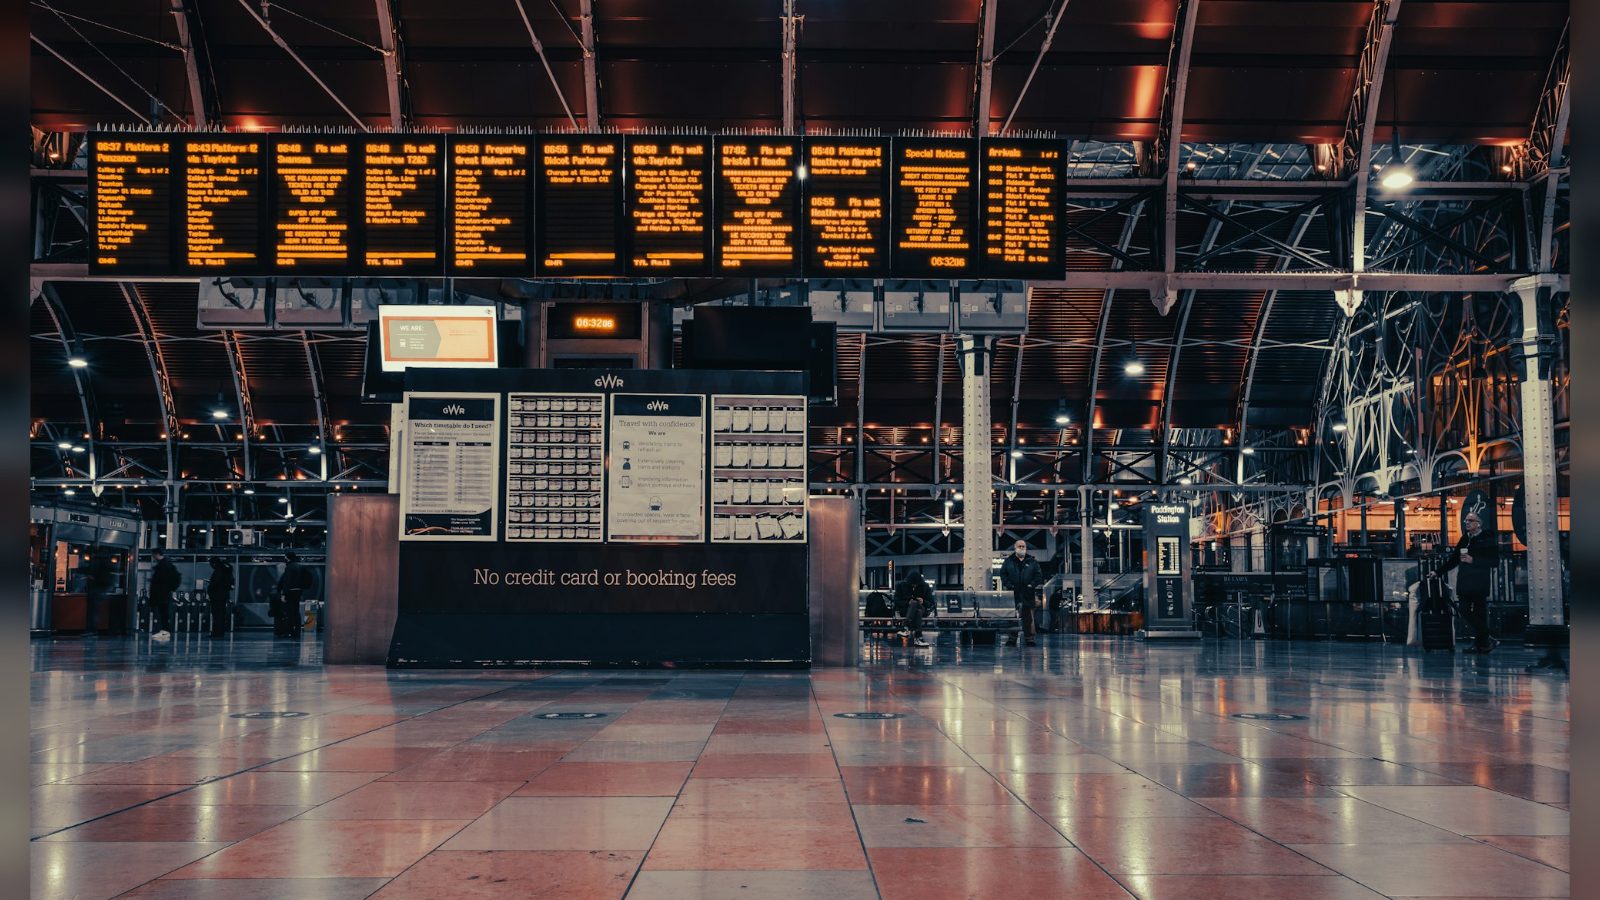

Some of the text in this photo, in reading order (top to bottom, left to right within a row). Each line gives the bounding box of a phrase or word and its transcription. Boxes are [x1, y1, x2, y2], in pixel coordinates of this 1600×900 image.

[162, 143, 170, 152] 2
[485, 145, 525, 154] Preparing
[723, 146, 746, 155] 07:02
[906, 149, 965, 158] Special Notices
[989, 148, 1021, 157] Arrivals
[97, 154, 136, 162] Penzance
[202, 155, 236, 164] Twyford
[366, 156, 404, 164] Heathrow
[455, 156, 513, 165] Great Malvern
[544, 156, 606, 166] Didcot Parkway
[648, 156, 682, 166] Twyford
[723, 157, 751, 166] Bristol
[752, 157, 759, 165] T
[811, 158, 881, 168] Heathrow Airport
[811, 208, 881, 218] Heathrow Airport
[594, 374, 624, 389] GWR
[443, 404, 464, 415] GWR
[647, 400, 669, 411] GWR
[659, 420, 695, 428] confidence
[1151, 505, 1185, 514] Paddington
[1157, 515, 1180, 523] Station
[473, 569, 736, 589] No credit card or booking fees
